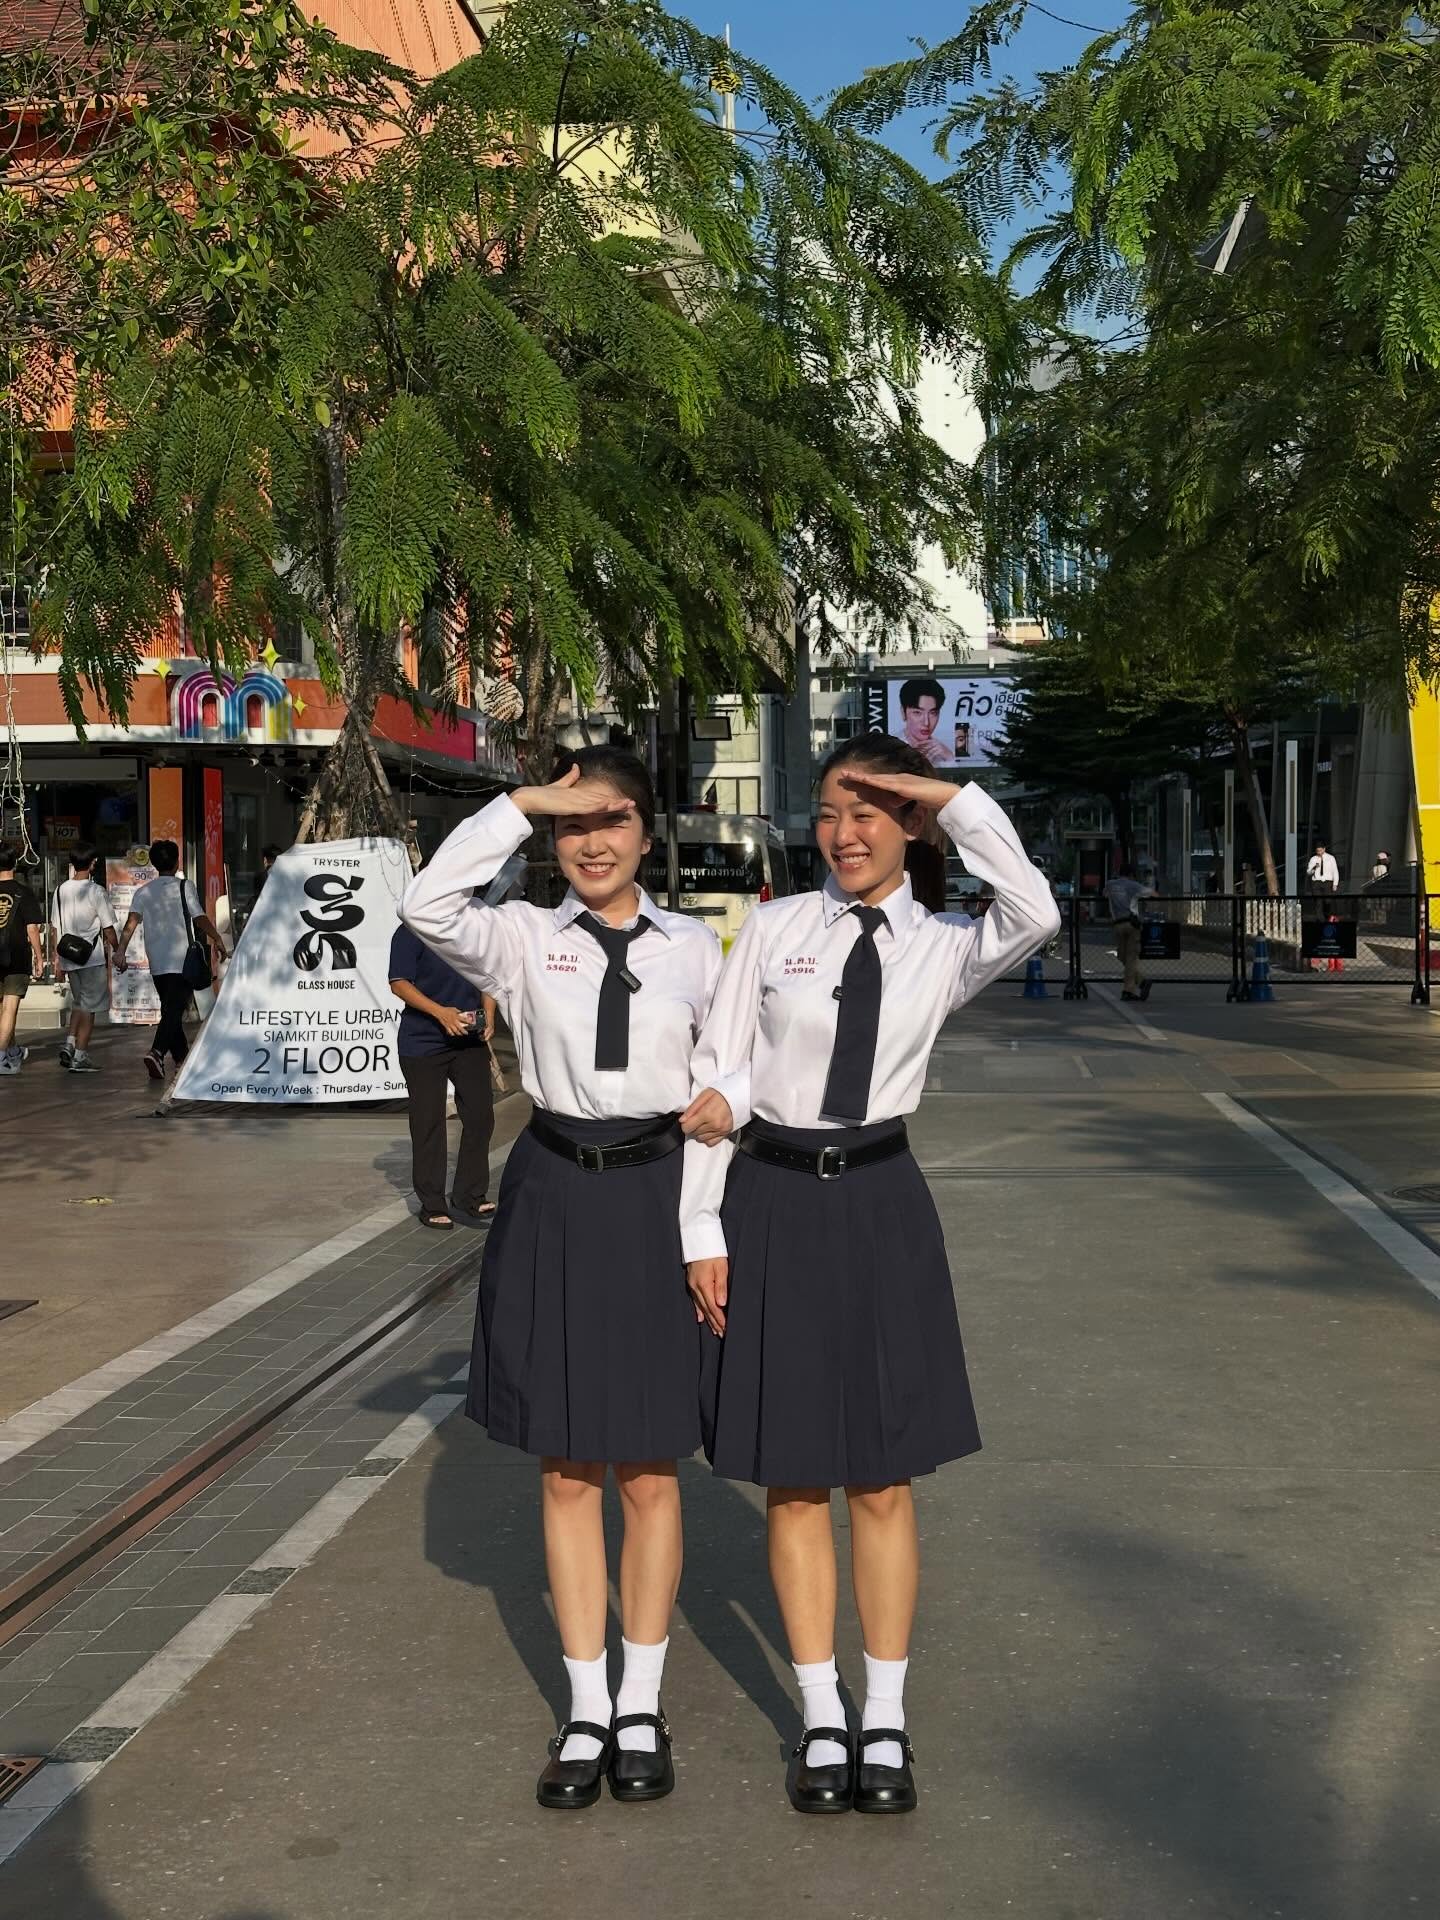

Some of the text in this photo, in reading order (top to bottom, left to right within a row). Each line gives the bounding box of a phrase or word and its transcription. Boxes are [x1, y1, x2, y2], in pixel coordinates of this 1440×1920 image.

[955, 682, 993, 717] คิ้ว
[312, 857, 360, 868] TRYSTER
[546, 964, 577, 973] 53620
[297, 980, 356, 990] GLASS HOUSE
[239, 1010, 340, 1026] LIFESTYLE
[263, 1028, 384, 1042] SIAMKIT BUILDING
[252, 1045, 390, 1075] 2 FLOOR
[211, 1083, 242, 1095] Open
[246, 1083, 278, 1096] Every
[281, 1085, 313, 1095] Week
[322, 1083, 372, 1096] Thursday
